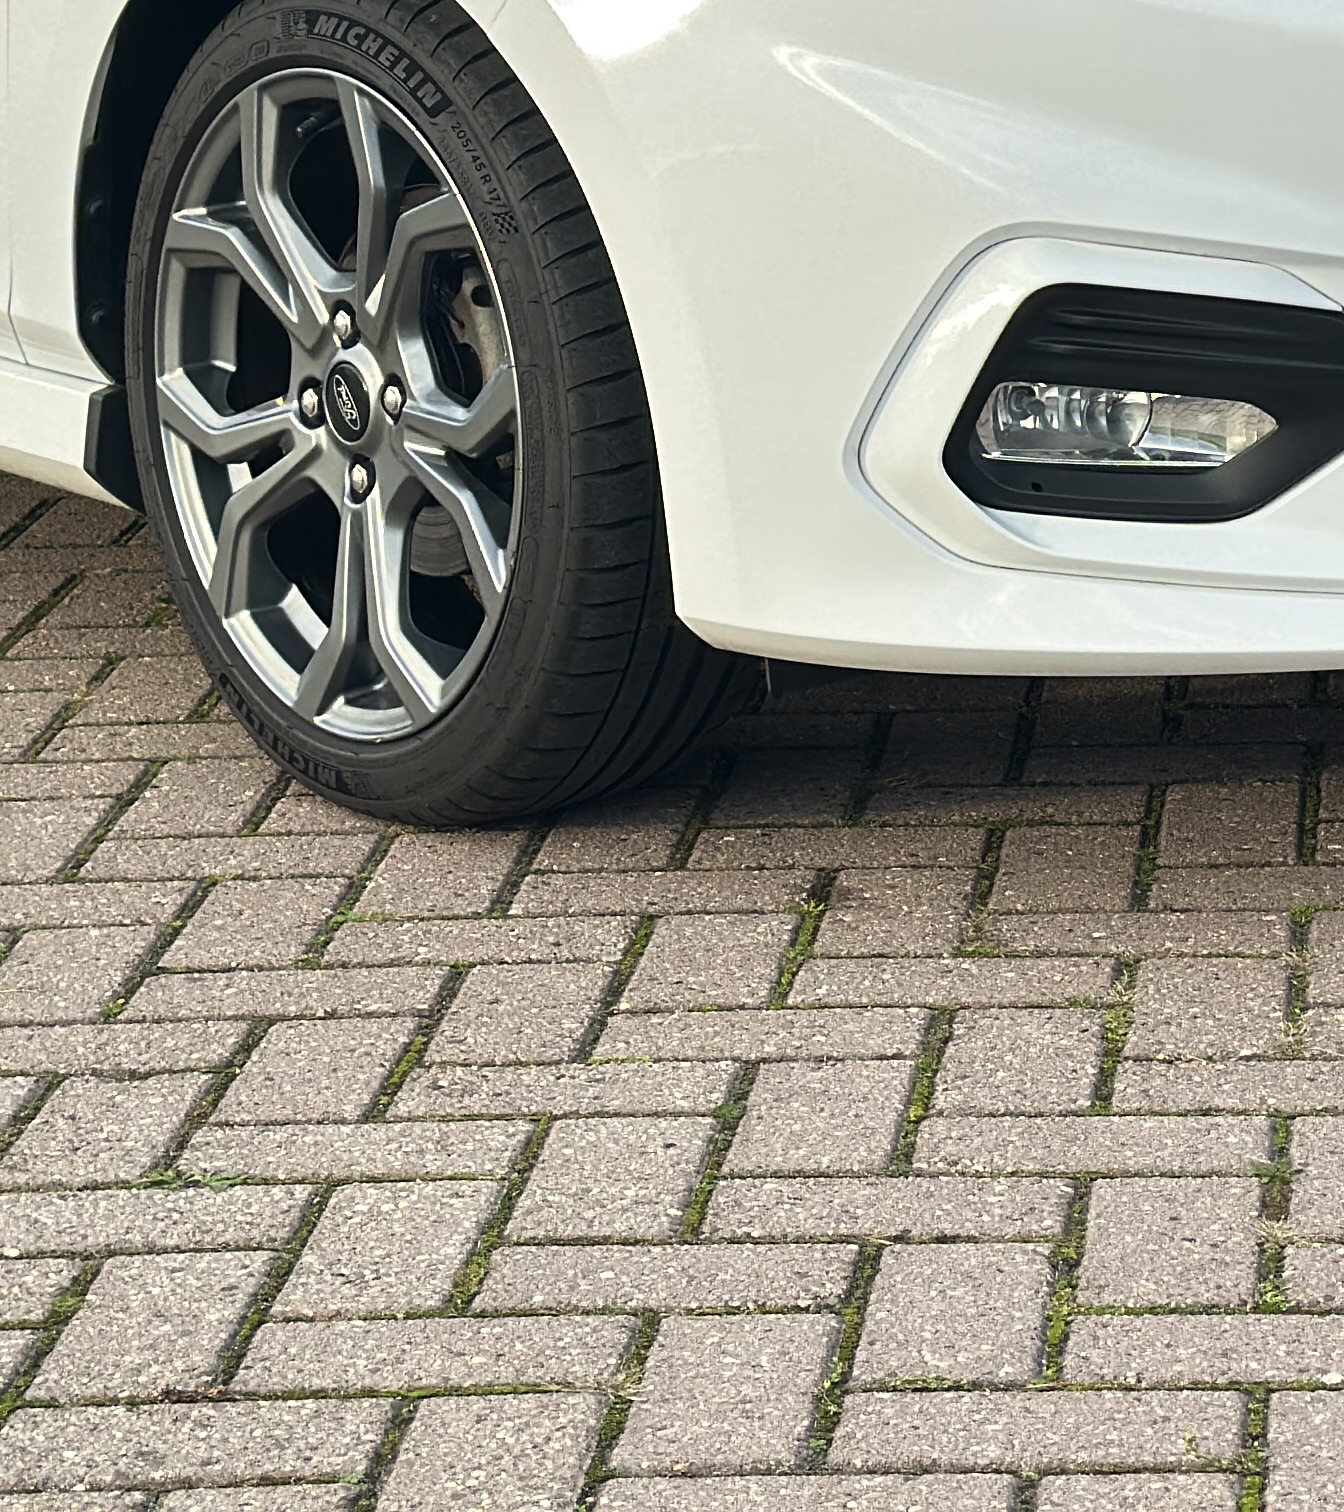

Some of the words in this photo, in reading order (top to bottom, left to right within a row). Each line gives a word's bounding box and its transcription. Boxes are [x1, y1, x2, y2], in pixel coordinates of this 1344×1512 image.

[312, 14, 444, 109] MICHELIN
[450, 121, 487, 173] 205/45
[479, 173, 493, 186] R
[337, 384, 357, 420] Ford
